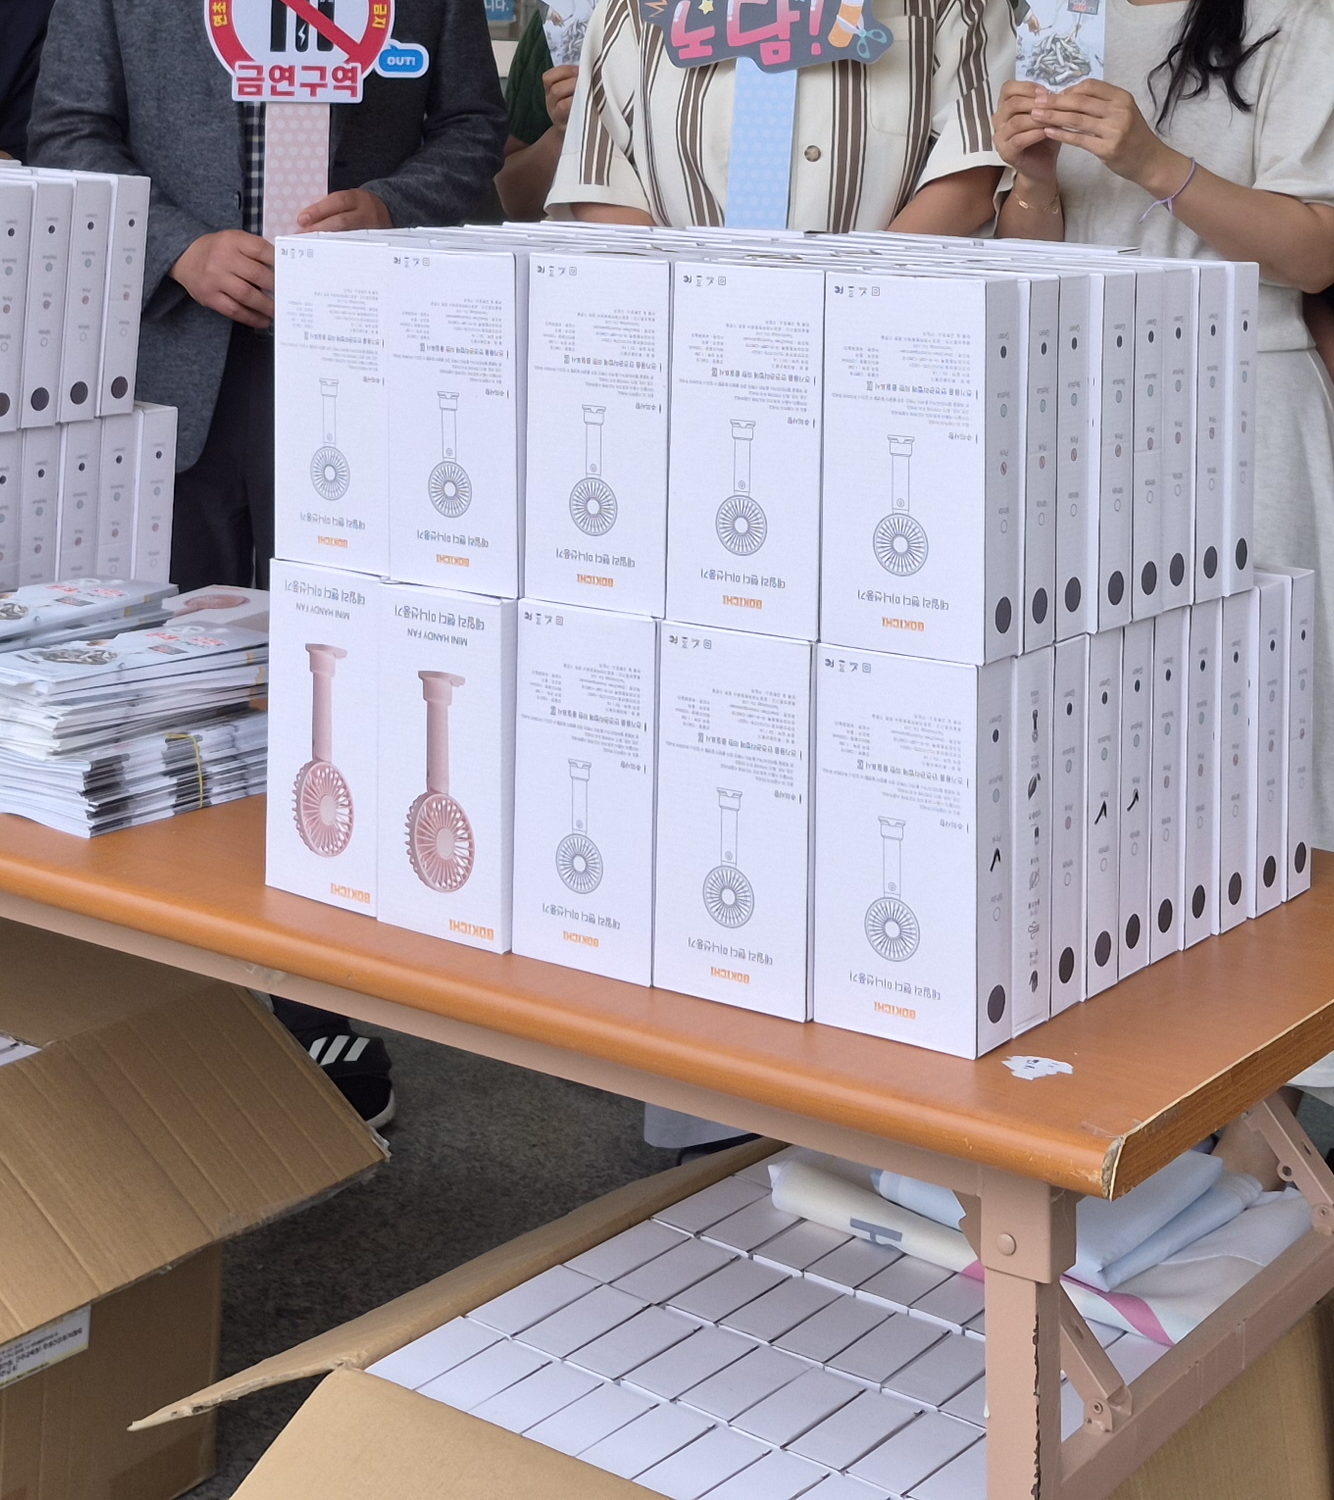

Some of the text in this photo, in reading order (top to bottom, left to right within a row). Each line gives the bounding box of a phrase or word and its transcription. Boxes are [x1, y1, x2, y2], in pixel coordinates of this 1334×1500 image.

[372, 3, 387, 29] 금지
[387, 56, 416, 66] OUT!
[236, 63, 358, 98] 금연구역
